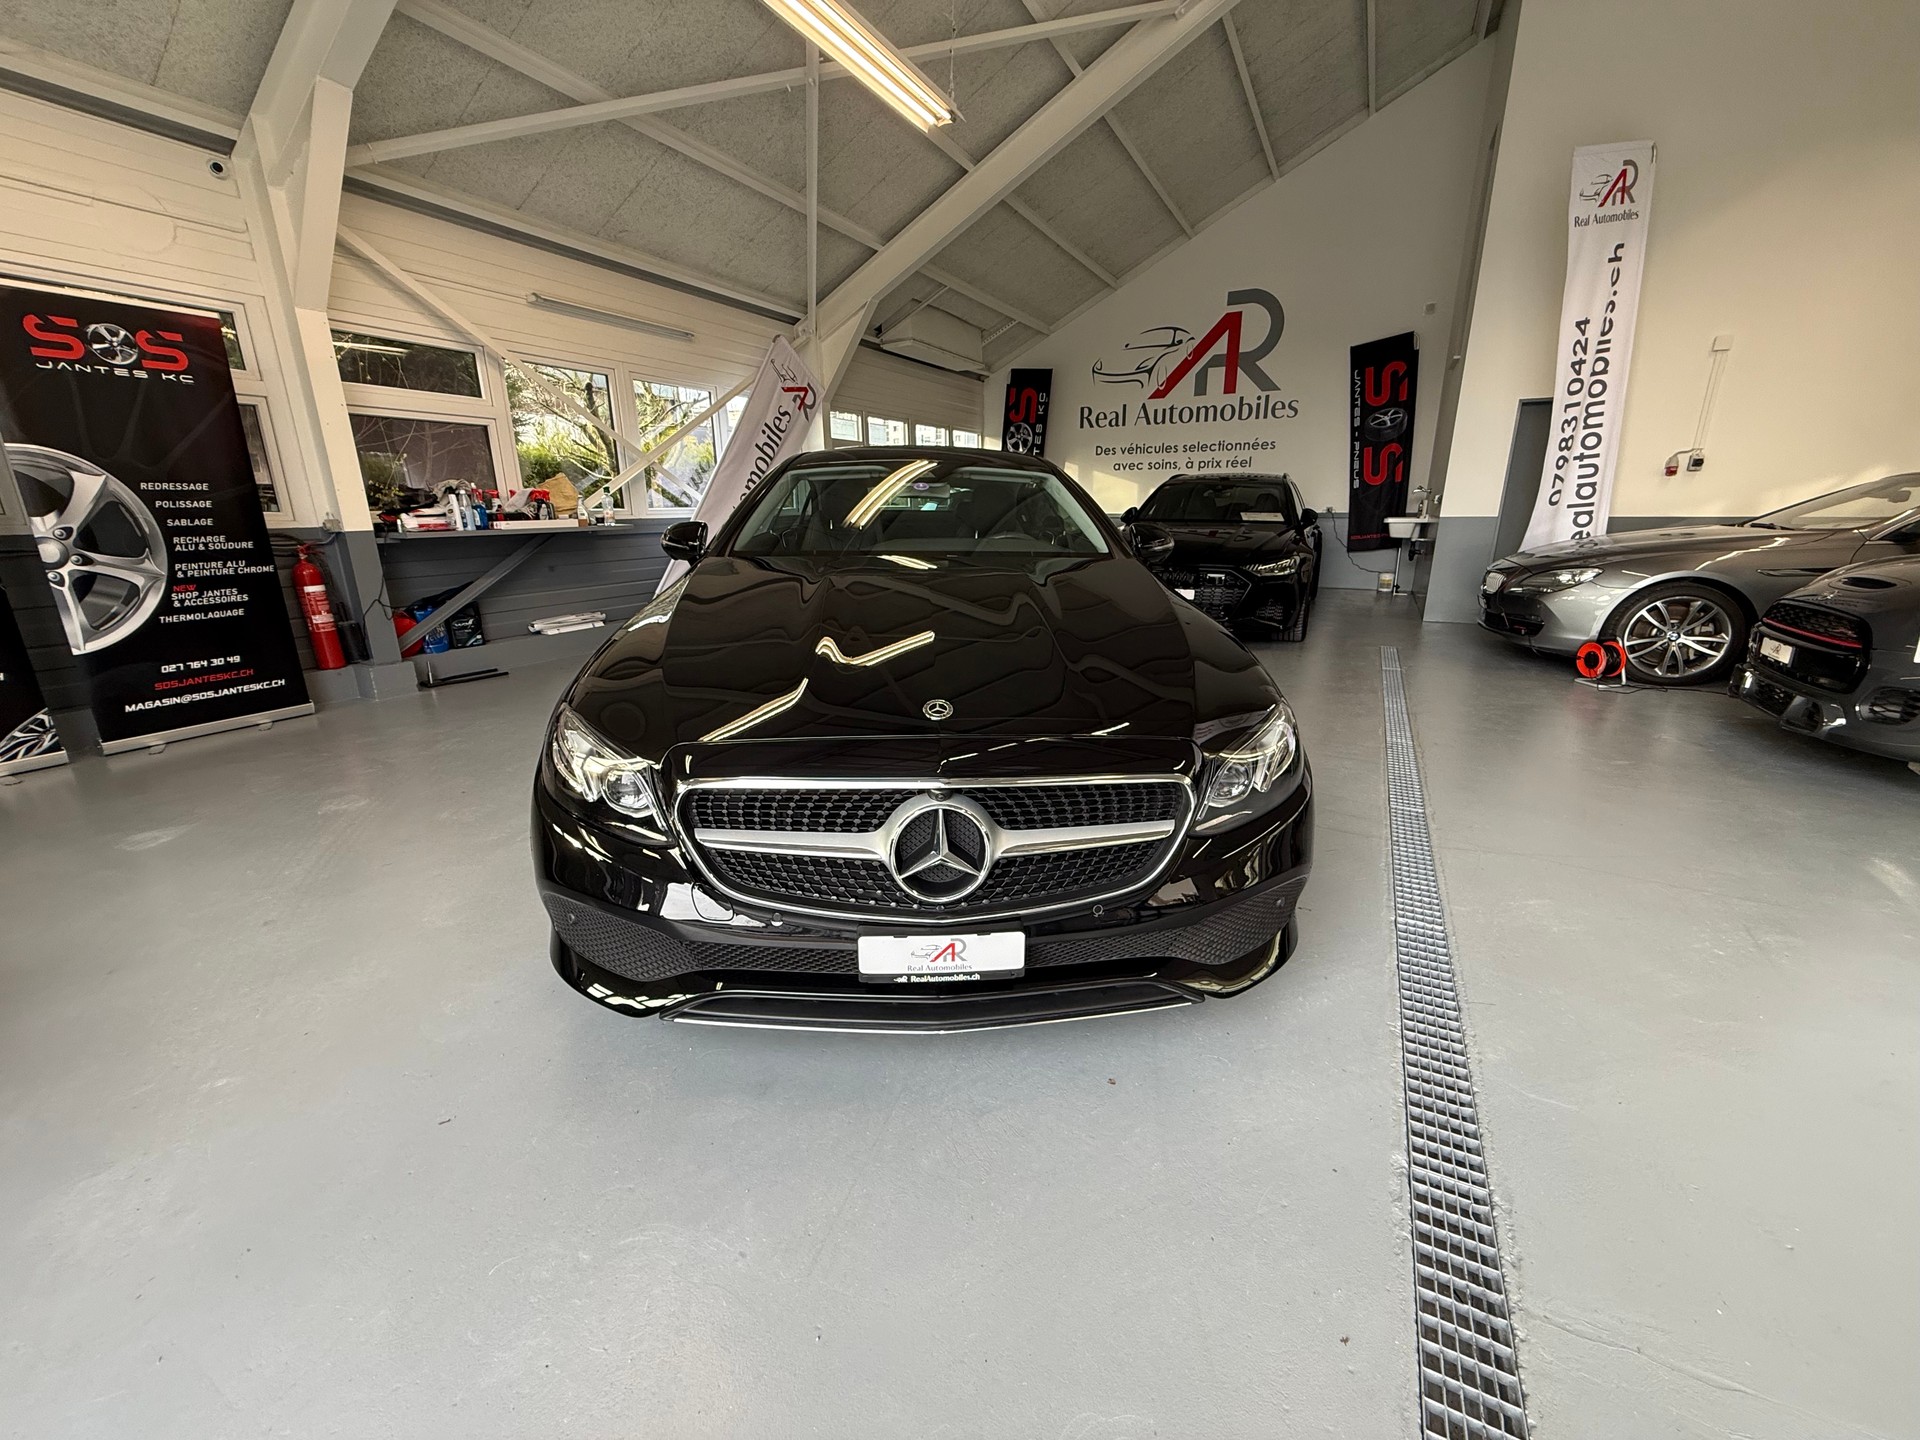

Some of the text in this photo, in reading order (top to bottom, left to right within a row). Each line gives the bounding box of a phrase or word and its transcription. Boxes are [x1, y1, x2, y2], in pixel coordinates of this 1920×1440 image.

[1573, 208, 1640, 228] Real Automobiles
[35, 360, 195, 384] JANTES KC
[1353, 369, 1361, 428] JANTES
[1079, 394, 1299, 429] Real Automobiles
[1547, 317, 1591, 507] 0798310424
[1095, 438, 1276, 456] Des véhicules selectionnées
[737, 405, 792, 504] mobiles
[1113, 456, 1252, 472] avec soins, à prix réel
[140, 482, 209, 491] REDRESSAGE
[155, 500, 213, 508] POLISSAGE
[166, 518, 214, 527] SABLAGE
[173, 535, 226, 544] RECHARGE
[174, 541, 254, 552] ALU & SOUDURE
[175, 560, 246, 571] PEINTURE ALU
[187, 567, 235, 577] PEINTURE
[237, 564, 275, 574] CHROME
[171, 588, 238, 601] SHOP JANTES
[173, 584, 197, 592] NEW
[173, 594, 249, 607] & ACCESSOIRES
[159, 608, 245, 624] THERMOLAQUAGE
[161, 655, 241, 673] 027 764 30 49
[154, 668, 255, 691] SOSJANTESKC.CH
[124, 678, 286, 713] MAGASIN@SOSJANTESKC.CH
[907, 963, 973, 972] Real Automobiles
[910, 973, 981, 983] RealAutomobiles.ch
